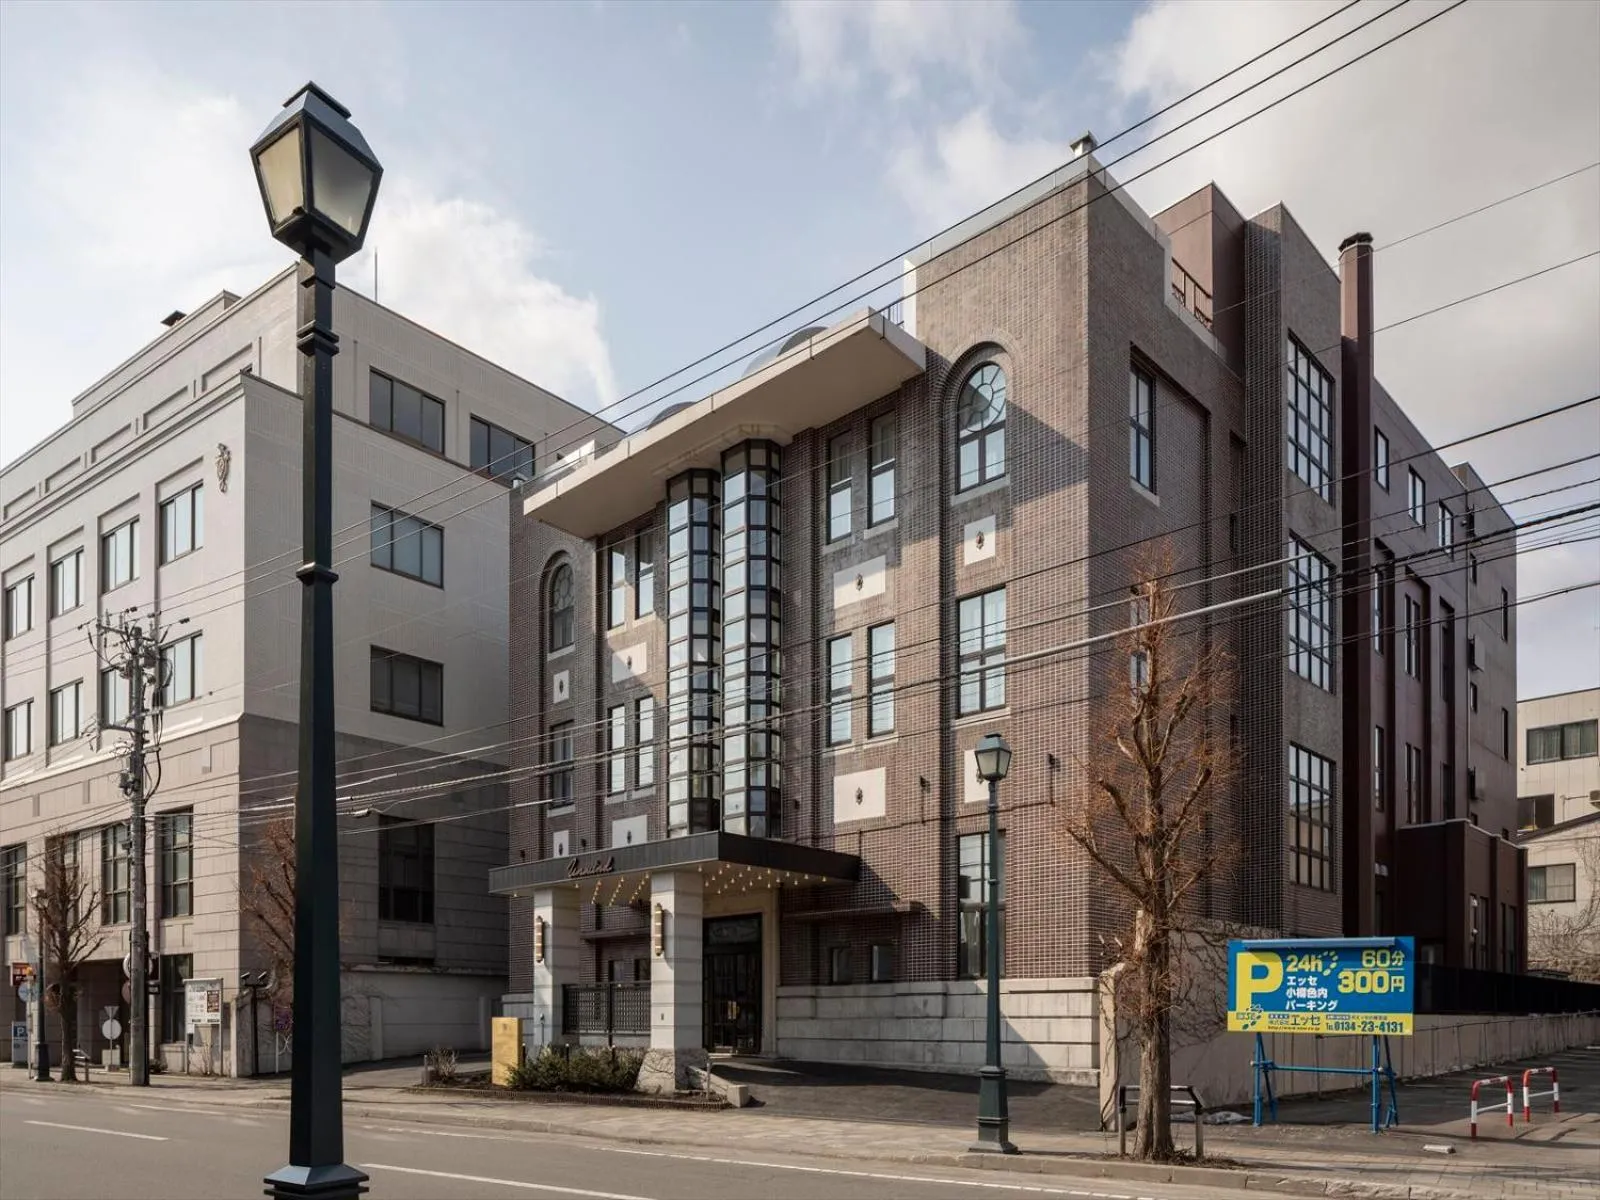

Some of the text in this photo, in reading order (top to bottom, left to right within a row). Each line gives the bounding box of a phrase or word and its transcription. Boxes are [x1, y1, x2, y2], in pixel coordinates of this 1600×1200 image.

[1286, 954, 1323, 972] 24h
[1362, 949, 1405, 968] 60分
[1236, 952, 1284, 1013] P
[1286, 975, 1318, 986] エッセ
[1337, 970, 1405, 993] 300円
[1334, 1020, 1404, 1033] 0134-23-4131
